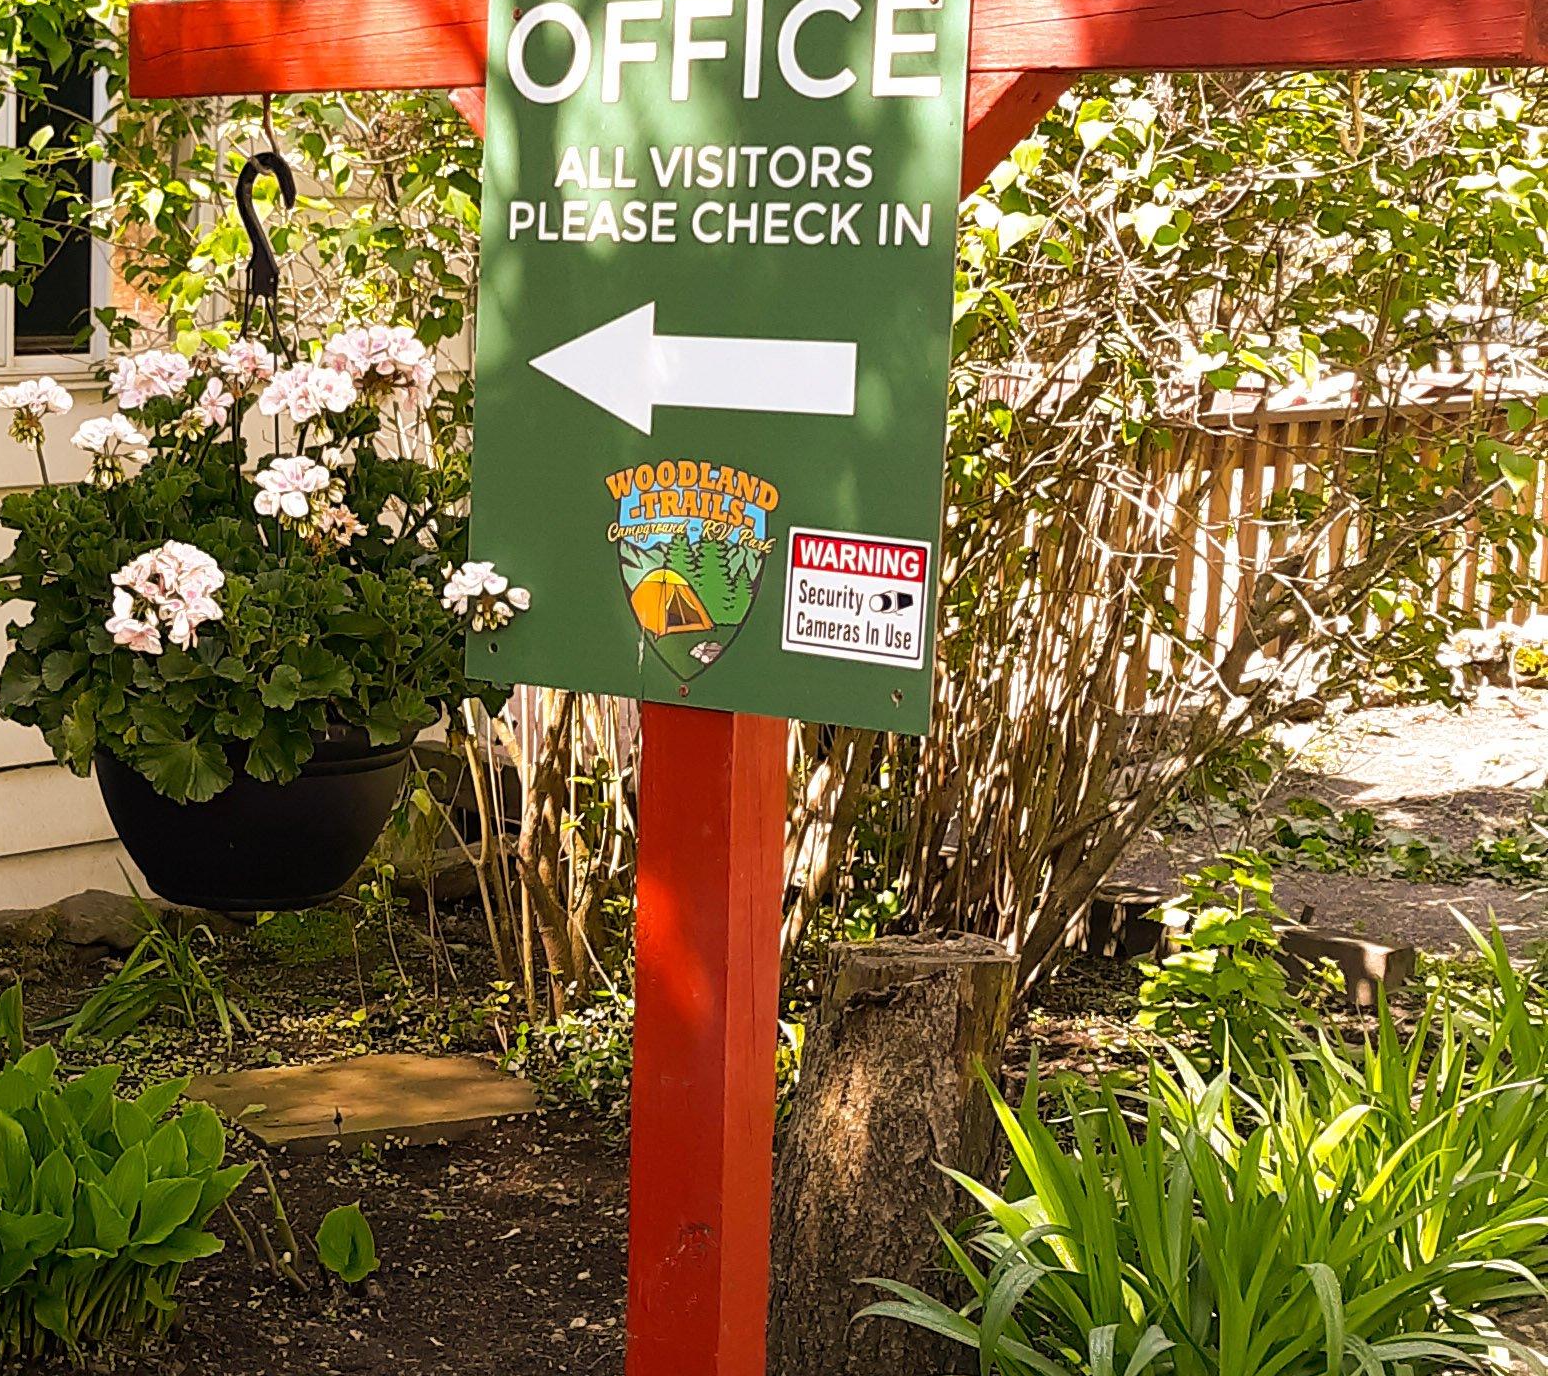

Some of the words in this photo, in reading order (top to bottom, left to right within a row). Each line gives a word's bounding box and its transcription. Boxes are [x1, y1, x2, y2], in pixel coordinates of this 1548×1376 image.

[555, 145, 636, 189] ALL
[650, 145, 873, 189] VISITORS
[509, 200, 676, 242] PLEASE
[691, 202, 860, 246] CHECK
[878, 203, 931, 246] IN
[605, 460, 779, 511] WOODLAND
[607, 519, 689, 542] Campground
[702, 519, 733, 541] RV
[739, 528, 777, 554] Park
[800, 539, 919, 578] WARNING
[798, 579, 864, 616] Security
[796, 611, 860, 643] Cameras
[866, 620, 879, 645] In
[885, 623, 912, 650] Use
